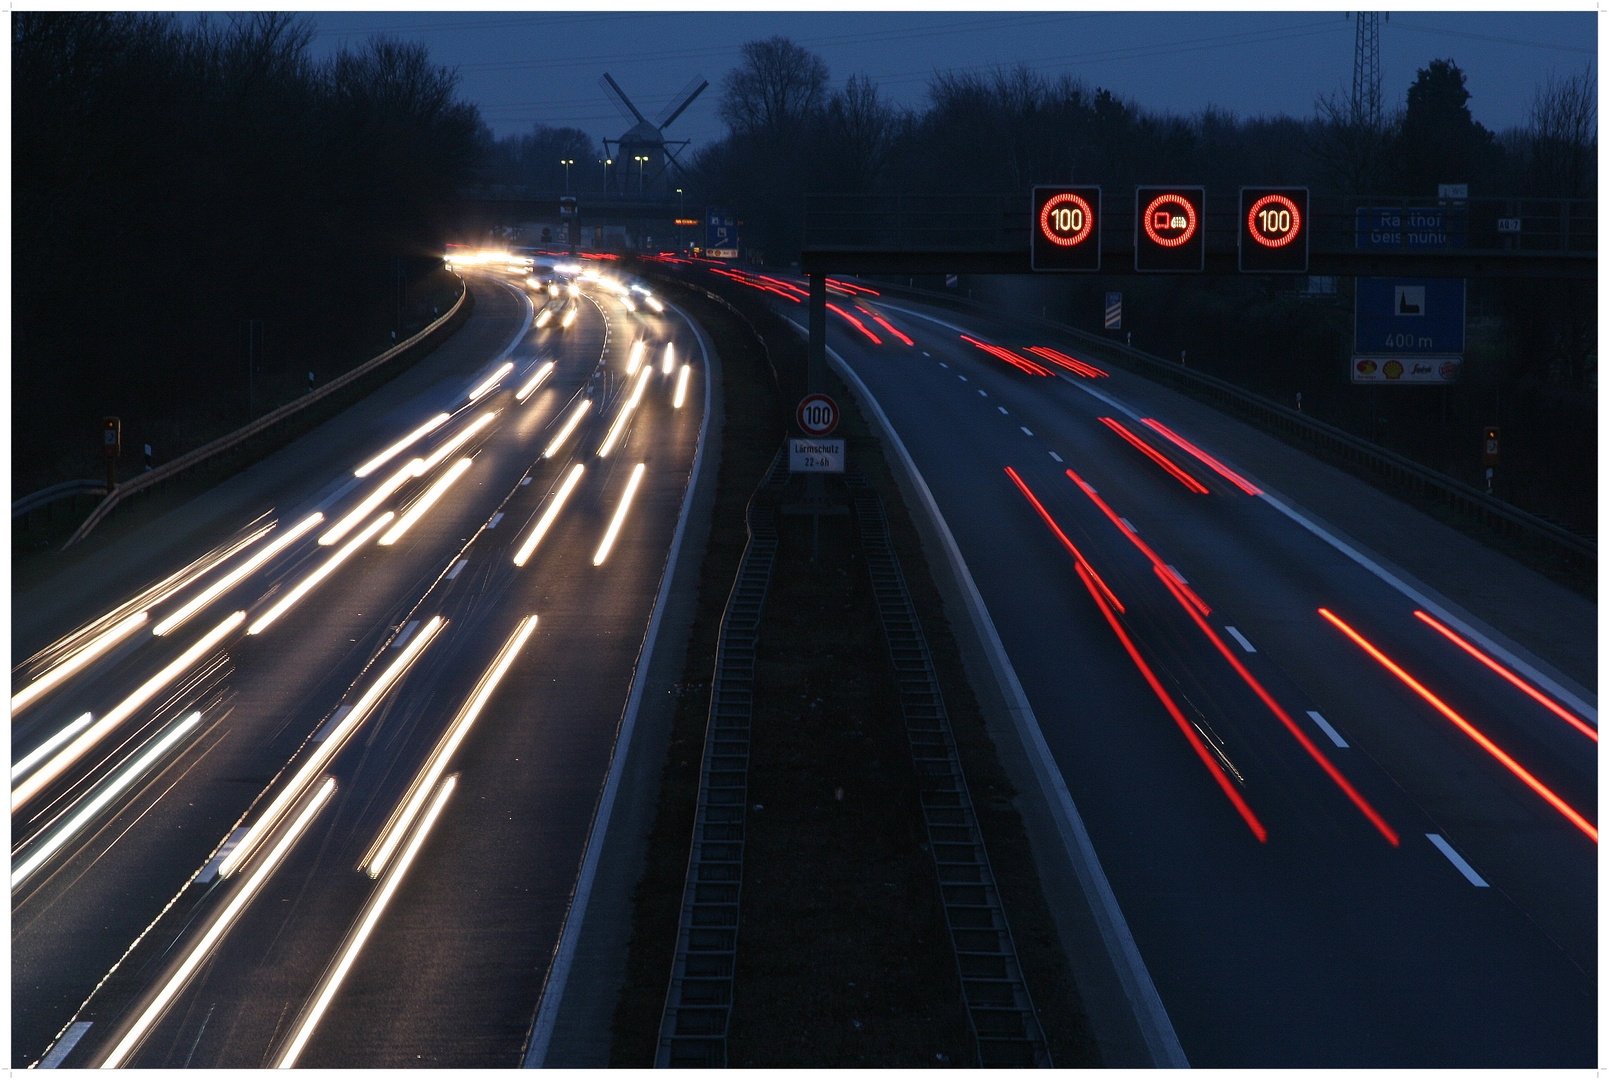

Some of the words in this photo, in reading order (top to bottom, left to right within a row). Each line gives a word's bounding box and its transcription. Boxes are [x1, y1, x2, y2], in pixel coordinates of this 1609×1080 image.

[1051, 208, 1082, 231] 100
[1258, 210, 1290, 232] 100
[1381, 212, 1442, 227] Rathof
[1371, 229, 1447, 243] Geismühl
[1385, 333, 1415, 348] 400
[1418, 336, 1433, 348] m
[806, 405, 831, 425] 100
[795, 444, 839, 454] Lärmschutz
